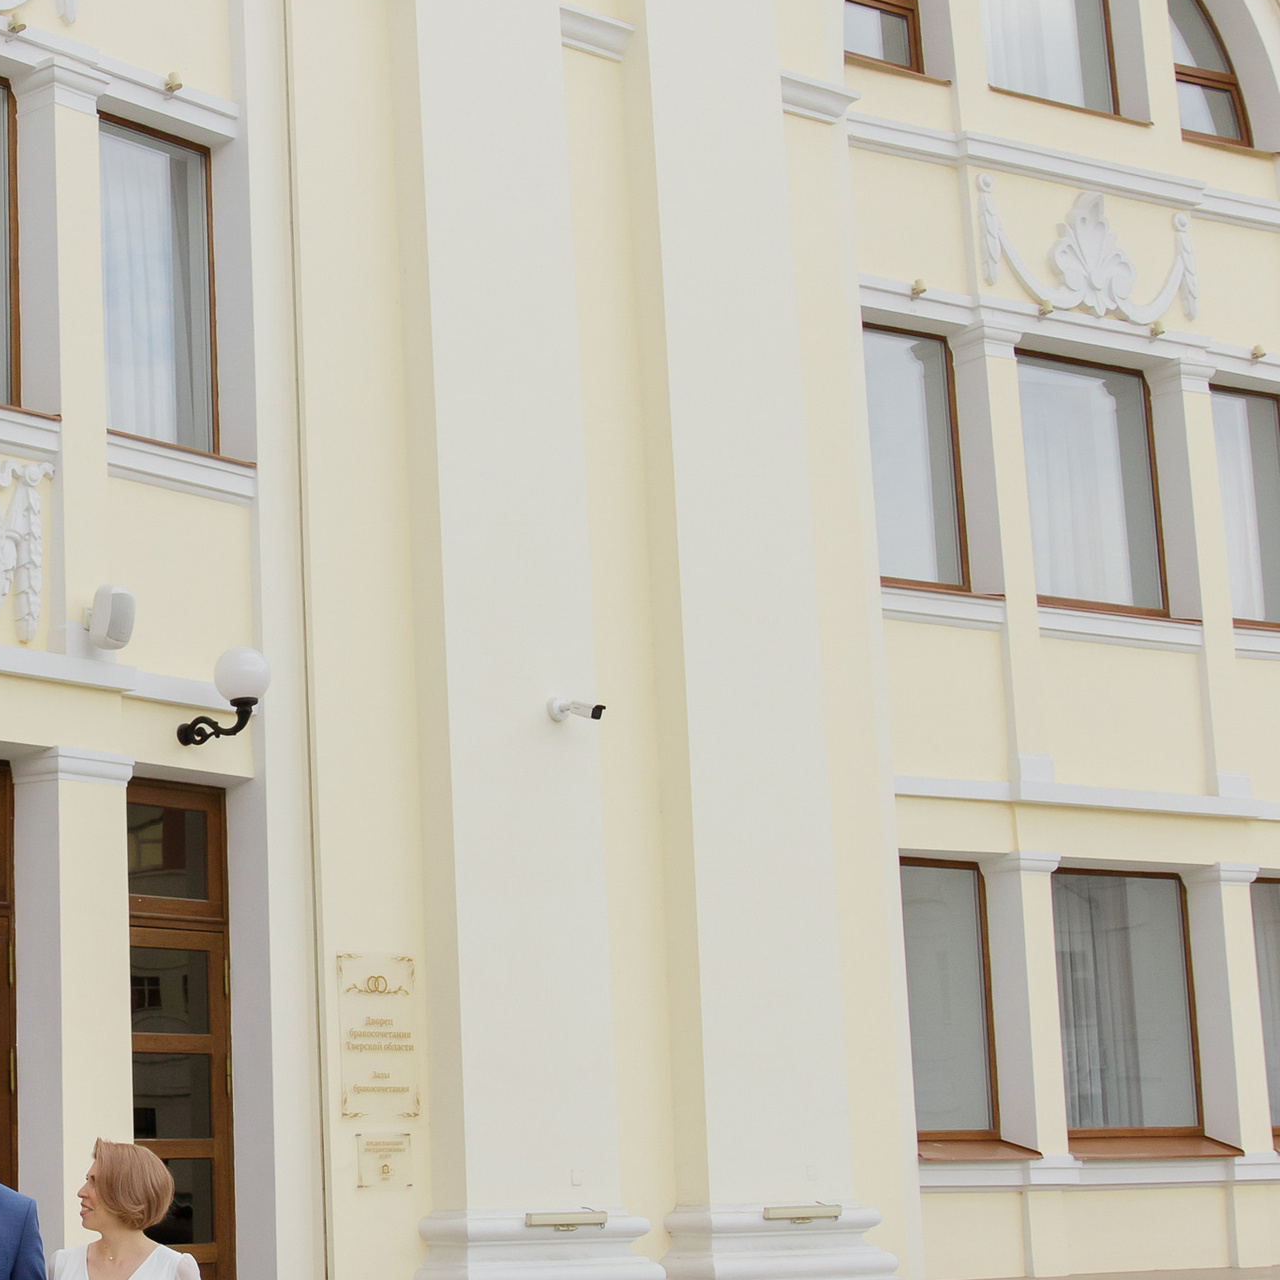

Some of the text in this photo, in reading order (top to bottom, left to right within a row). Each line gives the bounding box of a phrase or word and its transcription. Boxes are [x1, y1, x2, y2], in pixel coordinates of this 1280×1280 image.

[365, 1016, 394, 1027] Дворец
[349, 1028, 412, 1039] бракосочетания
[345, 1041, 414, 1052] Тверской области
